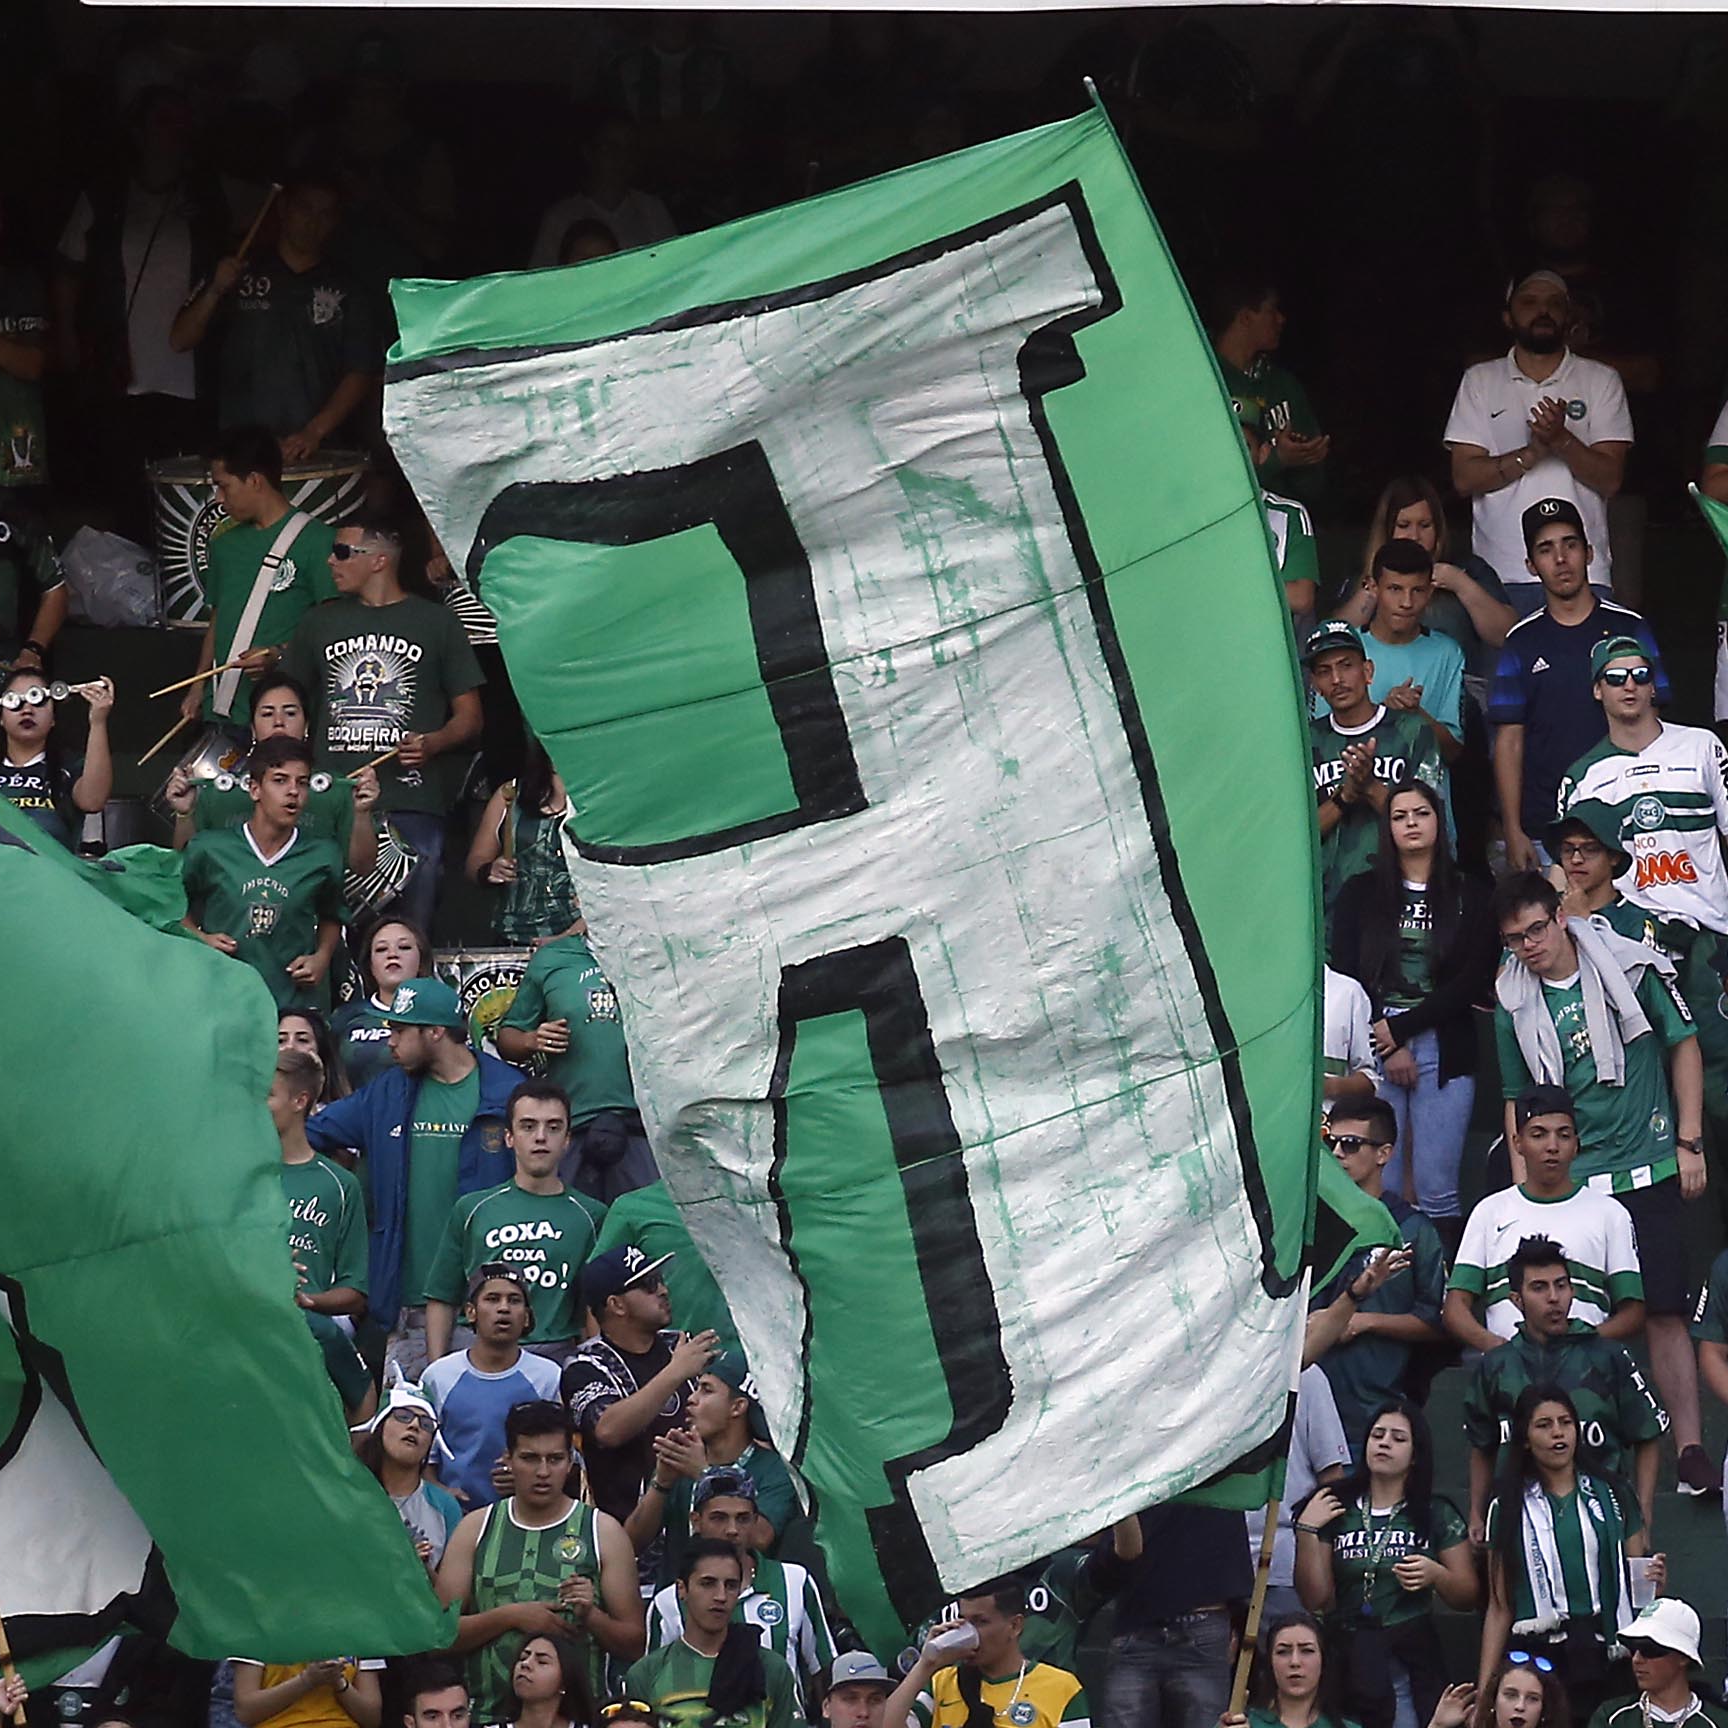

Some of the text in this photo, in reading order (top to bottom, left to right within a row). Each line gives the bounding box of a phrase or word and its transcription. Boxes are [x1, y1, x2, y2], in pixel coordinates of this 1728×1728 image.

[239, 274, 273, 298] 39
[325, 632, 423, 663] COMANDO
[485, 1220, 563, 1250] COXA,
[502, 1247, 546, 1262] COXA
